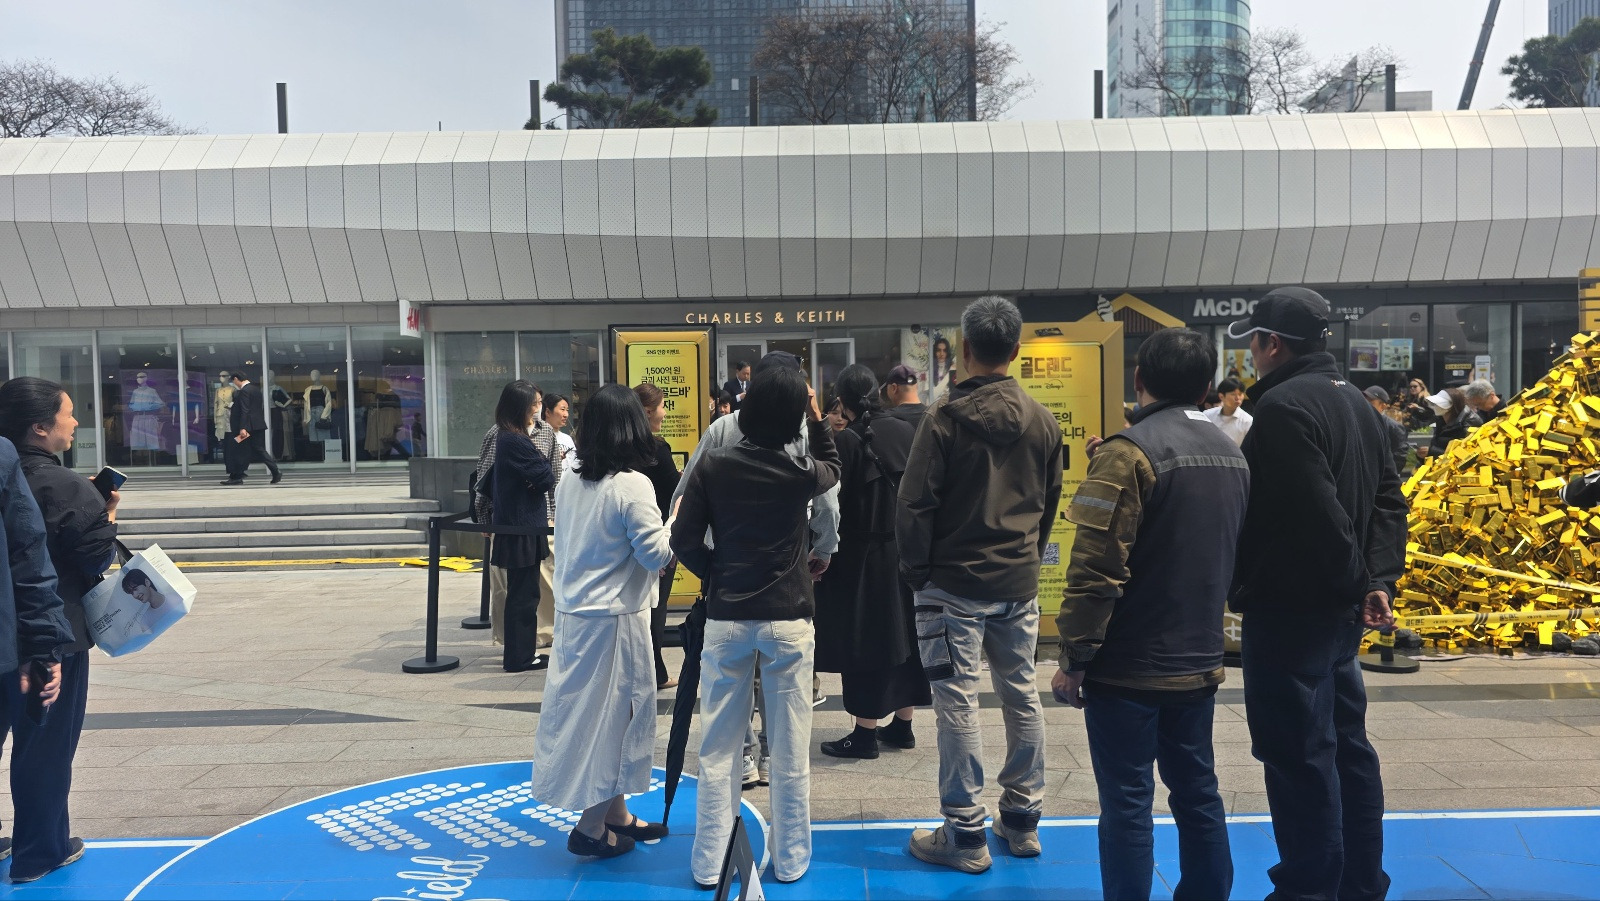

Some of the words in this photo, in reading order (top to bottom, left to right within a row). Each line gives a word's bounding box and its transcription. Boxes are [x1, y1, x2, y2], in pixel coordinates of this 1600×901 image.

[407, 307, 420, 332] H&M
[685, 311, 763, 325] CHARLES
[774, 311, 784, 324] &
[796, 310, 845, 323] KEITH
[645, 366, 672, 376] 1,500억
[673, 366, 681, 375] 원
[1021, 357, 1072, 379] 골드랜드
[656, 375, 670, 385] 사진
[1044, 379, 1064, 390] Disney+
[372, 854, 491, 901] ield
